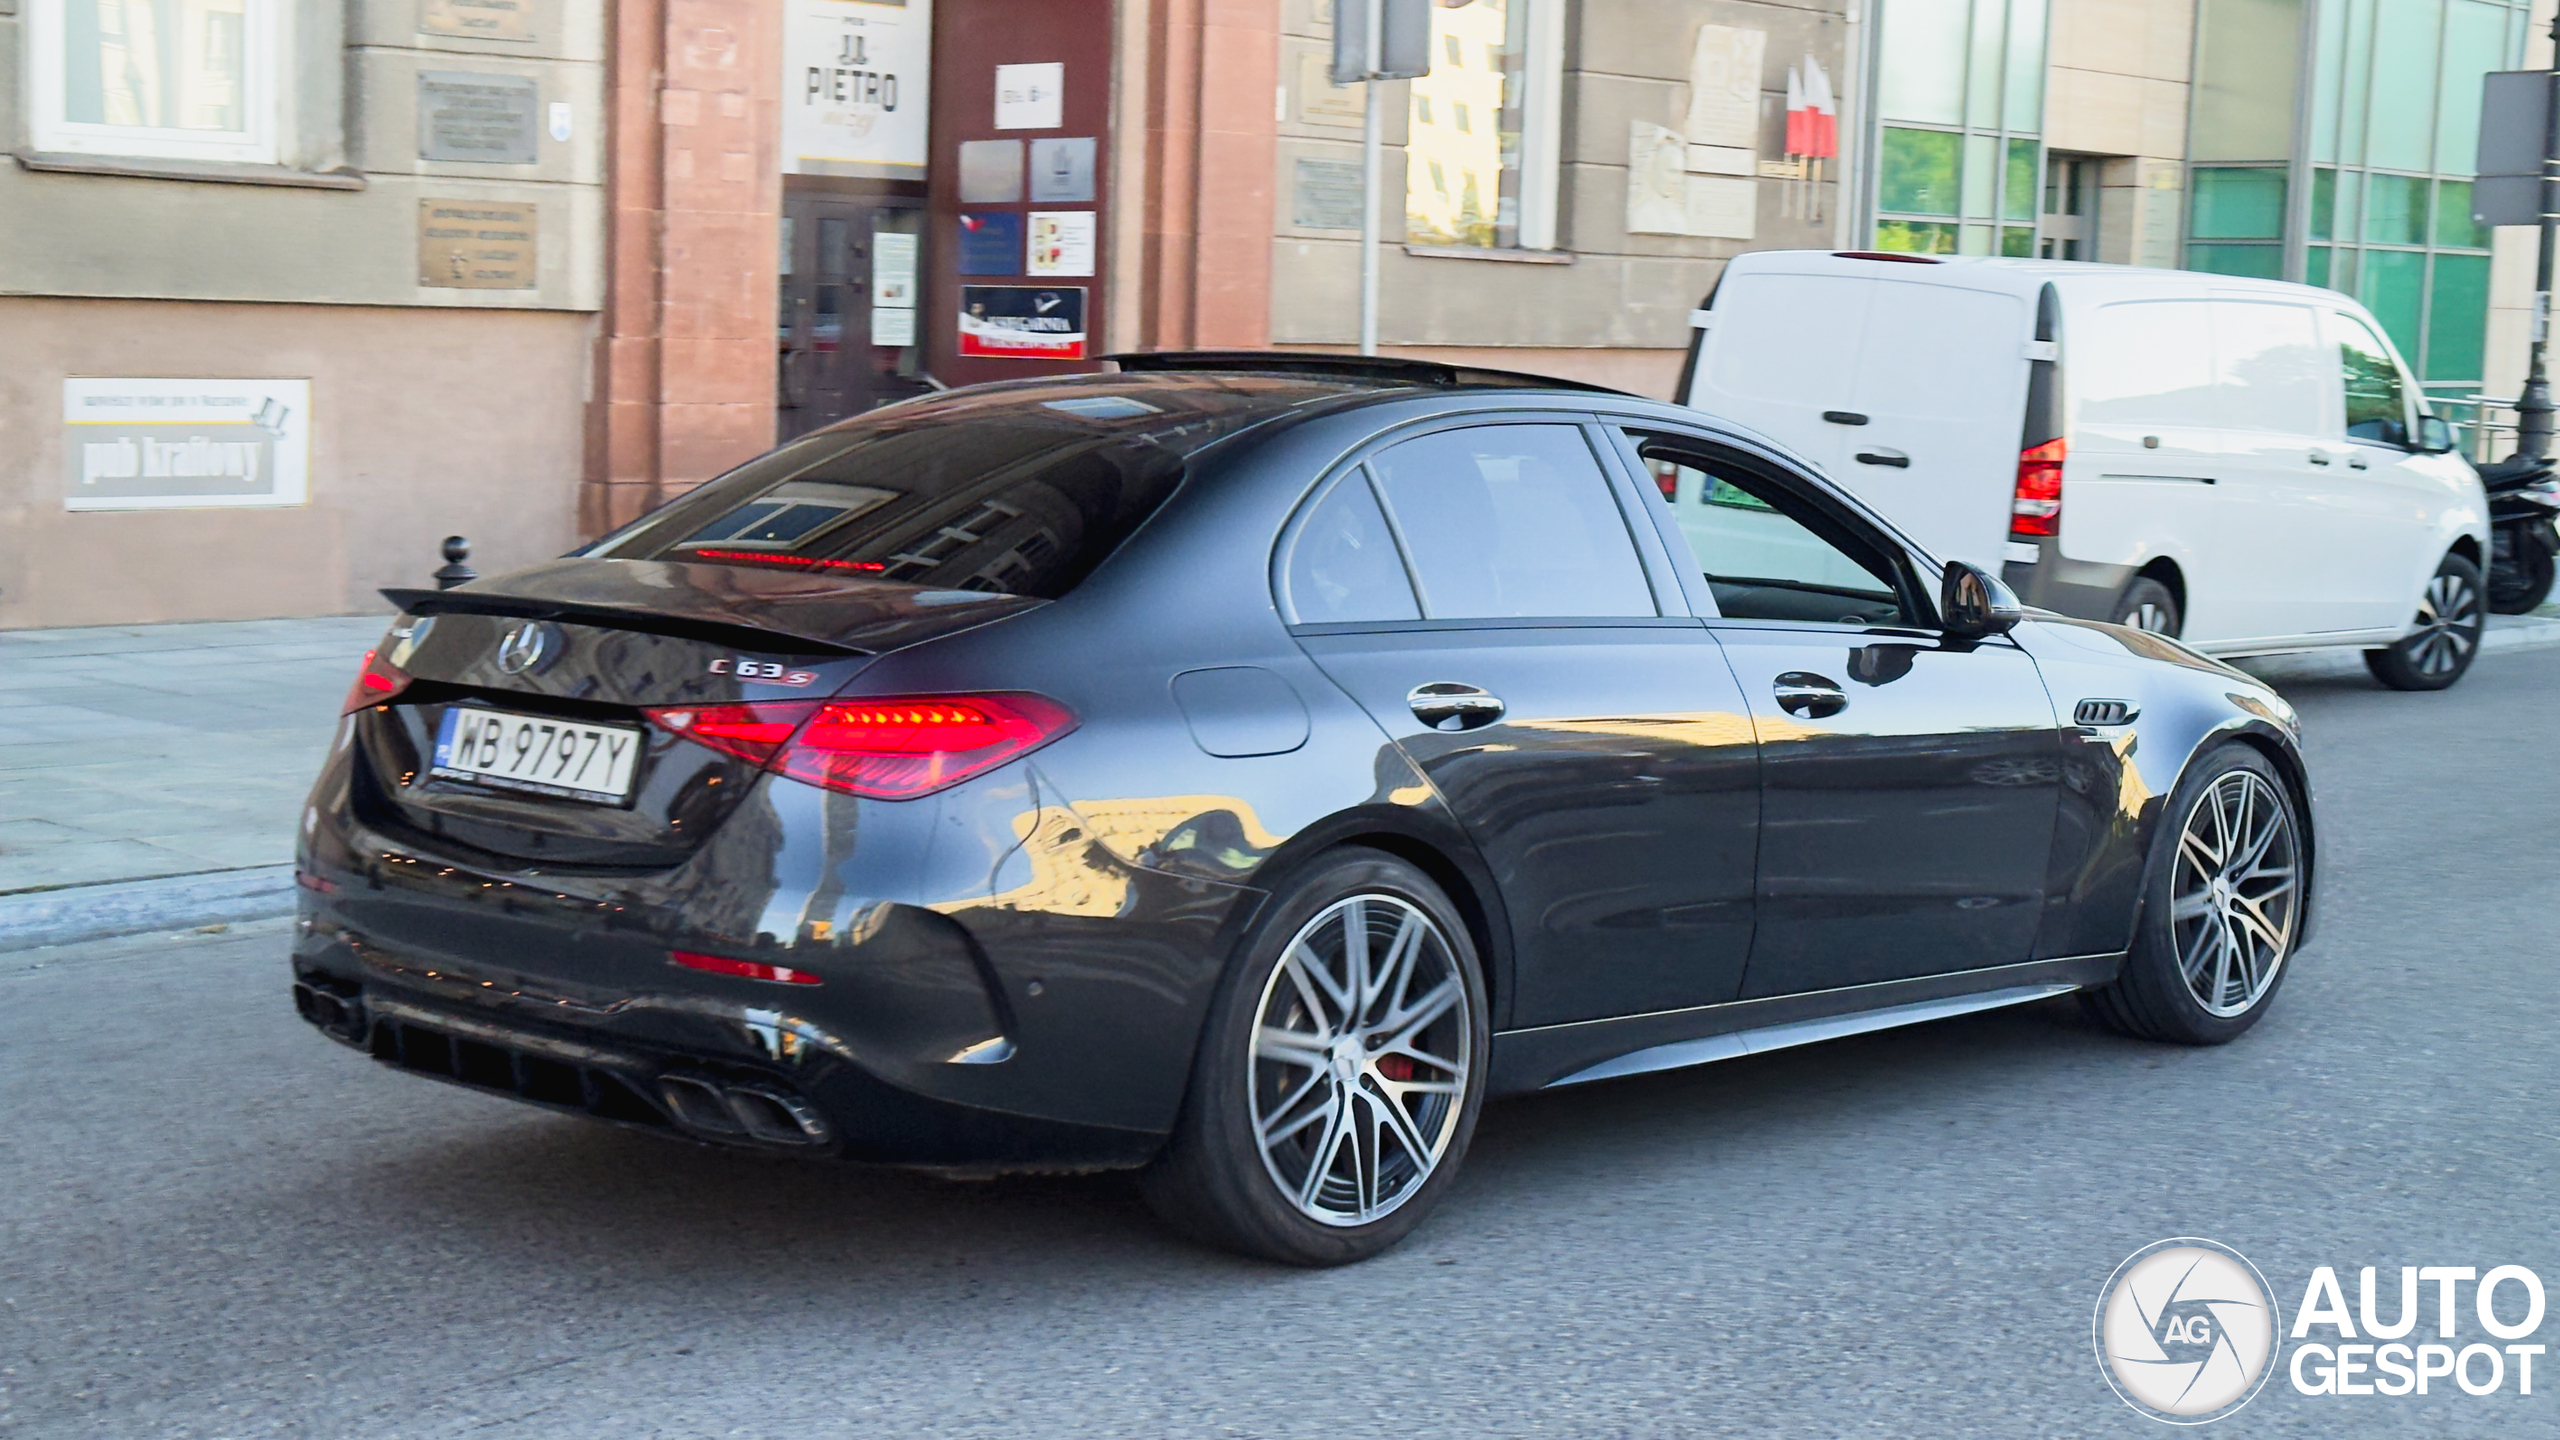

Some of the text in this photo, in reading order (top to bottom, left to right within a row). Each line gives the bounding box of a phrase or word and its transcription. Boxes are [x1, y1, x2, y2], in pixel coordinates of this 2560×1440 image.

[82, 436, 140, 484] pub
[709, 659, 731, 674] C
[736, 661, 783, 678] 63
[457, 714, 629, 788] WB 9797Y
